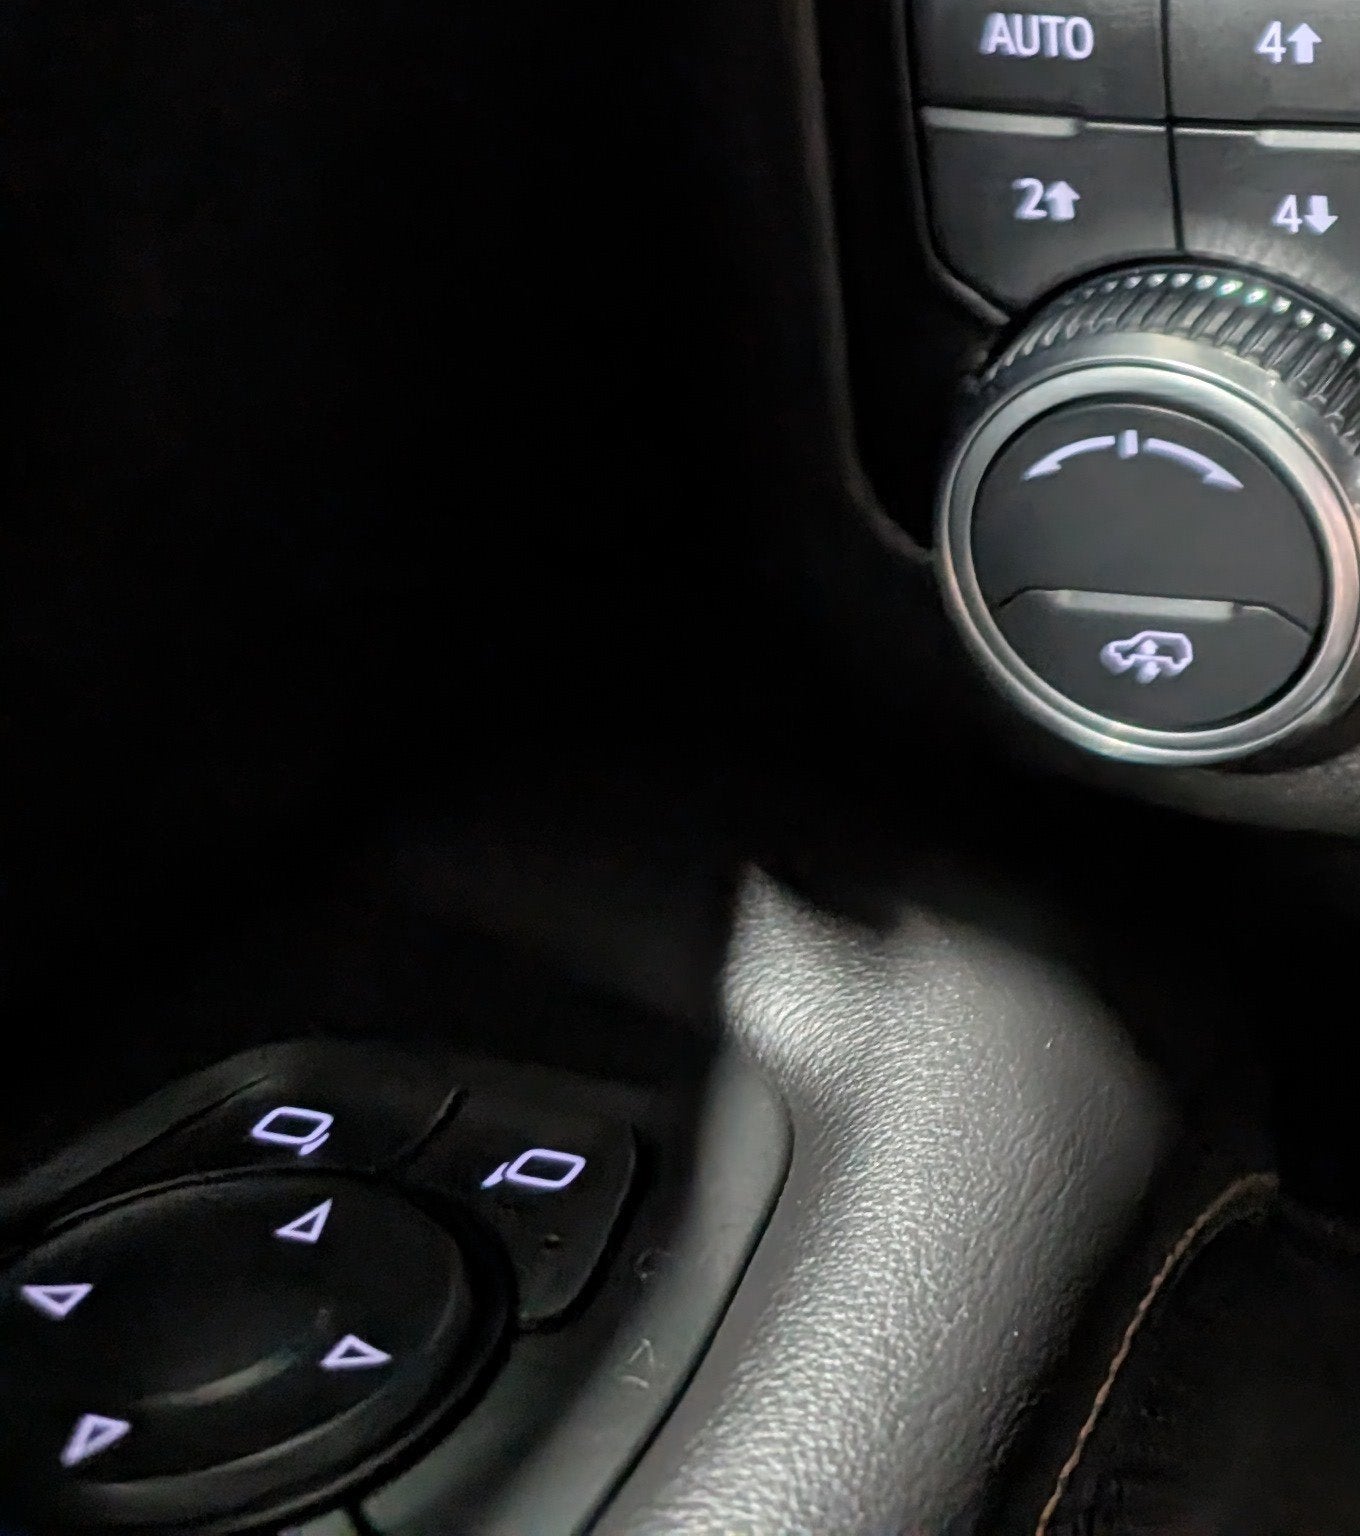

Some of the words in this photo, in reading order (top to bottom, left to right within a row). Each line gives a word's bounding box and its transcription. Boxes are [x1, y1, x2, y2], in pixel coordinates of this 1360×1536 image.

[981, 12, 1095, 60] AUTO
[1256, 20, 1287, 63] 4
[1013, 177, 1047, 220] 2
[1272, 194, 1304, 234] 4
